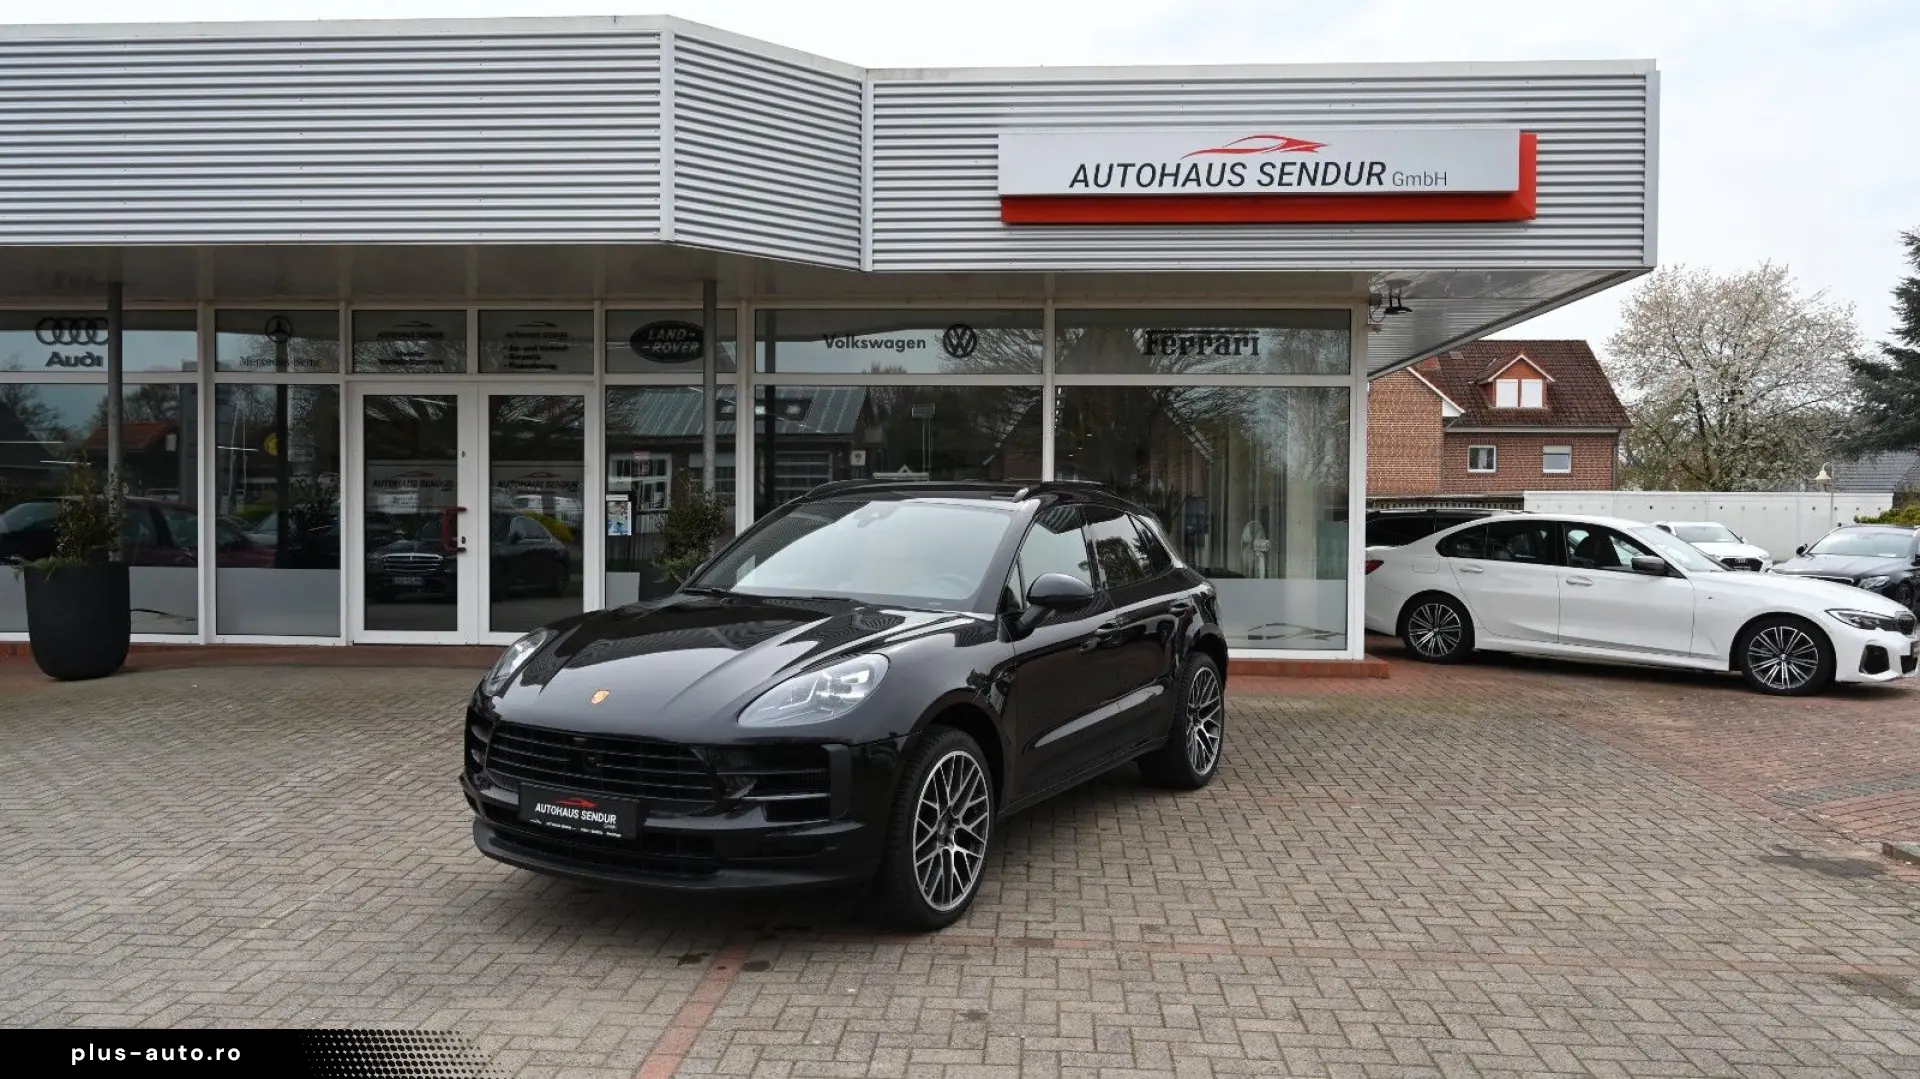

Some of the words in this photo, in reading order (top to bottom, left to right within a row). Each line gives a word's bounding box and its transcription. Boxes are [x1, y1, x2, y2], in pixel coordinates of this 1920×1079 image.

[1068, 162, 1247, 188] AUTOHAUS
[1256, 161, 1387, 187] SENDUR
[1391, 170, 1447, 187] GmbH
[648, 328, 687, 340] LAND
[823, 333, 926, 353] Volkswagen
[1143, 329, 1260, 356] Ferrari
[652, 342, 699, 353] ROVER
[45, 351, 104, 367] Audi
[535, 803, 579, 819] AUTOHAUS
[580, 810, 617, 824] SENDUR
